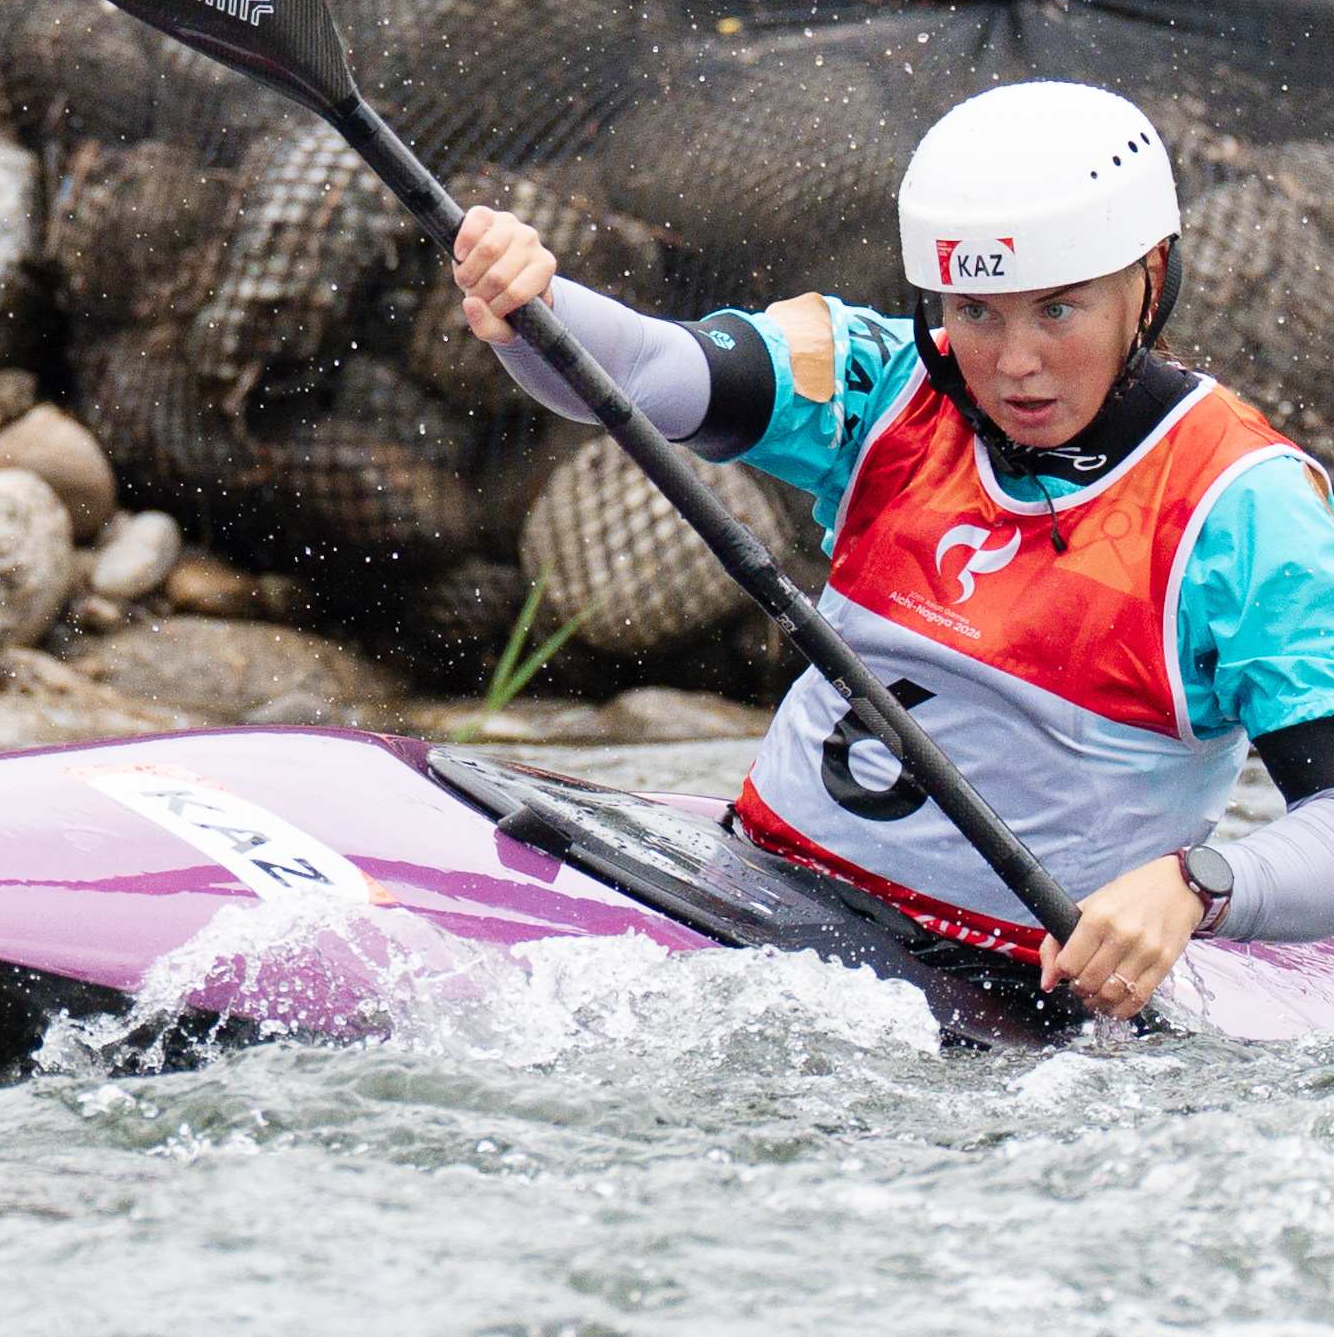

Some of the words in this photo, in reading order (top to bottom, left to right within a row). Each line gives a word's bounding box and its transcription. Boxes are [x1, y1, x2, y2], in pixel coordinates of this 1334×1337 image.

[957, 254, 1005, 277] KAZ
[952, 622, 981, 640] 2026
[820, 677, 938, 822] 6
[140, 789, 337, 889] KAZ
